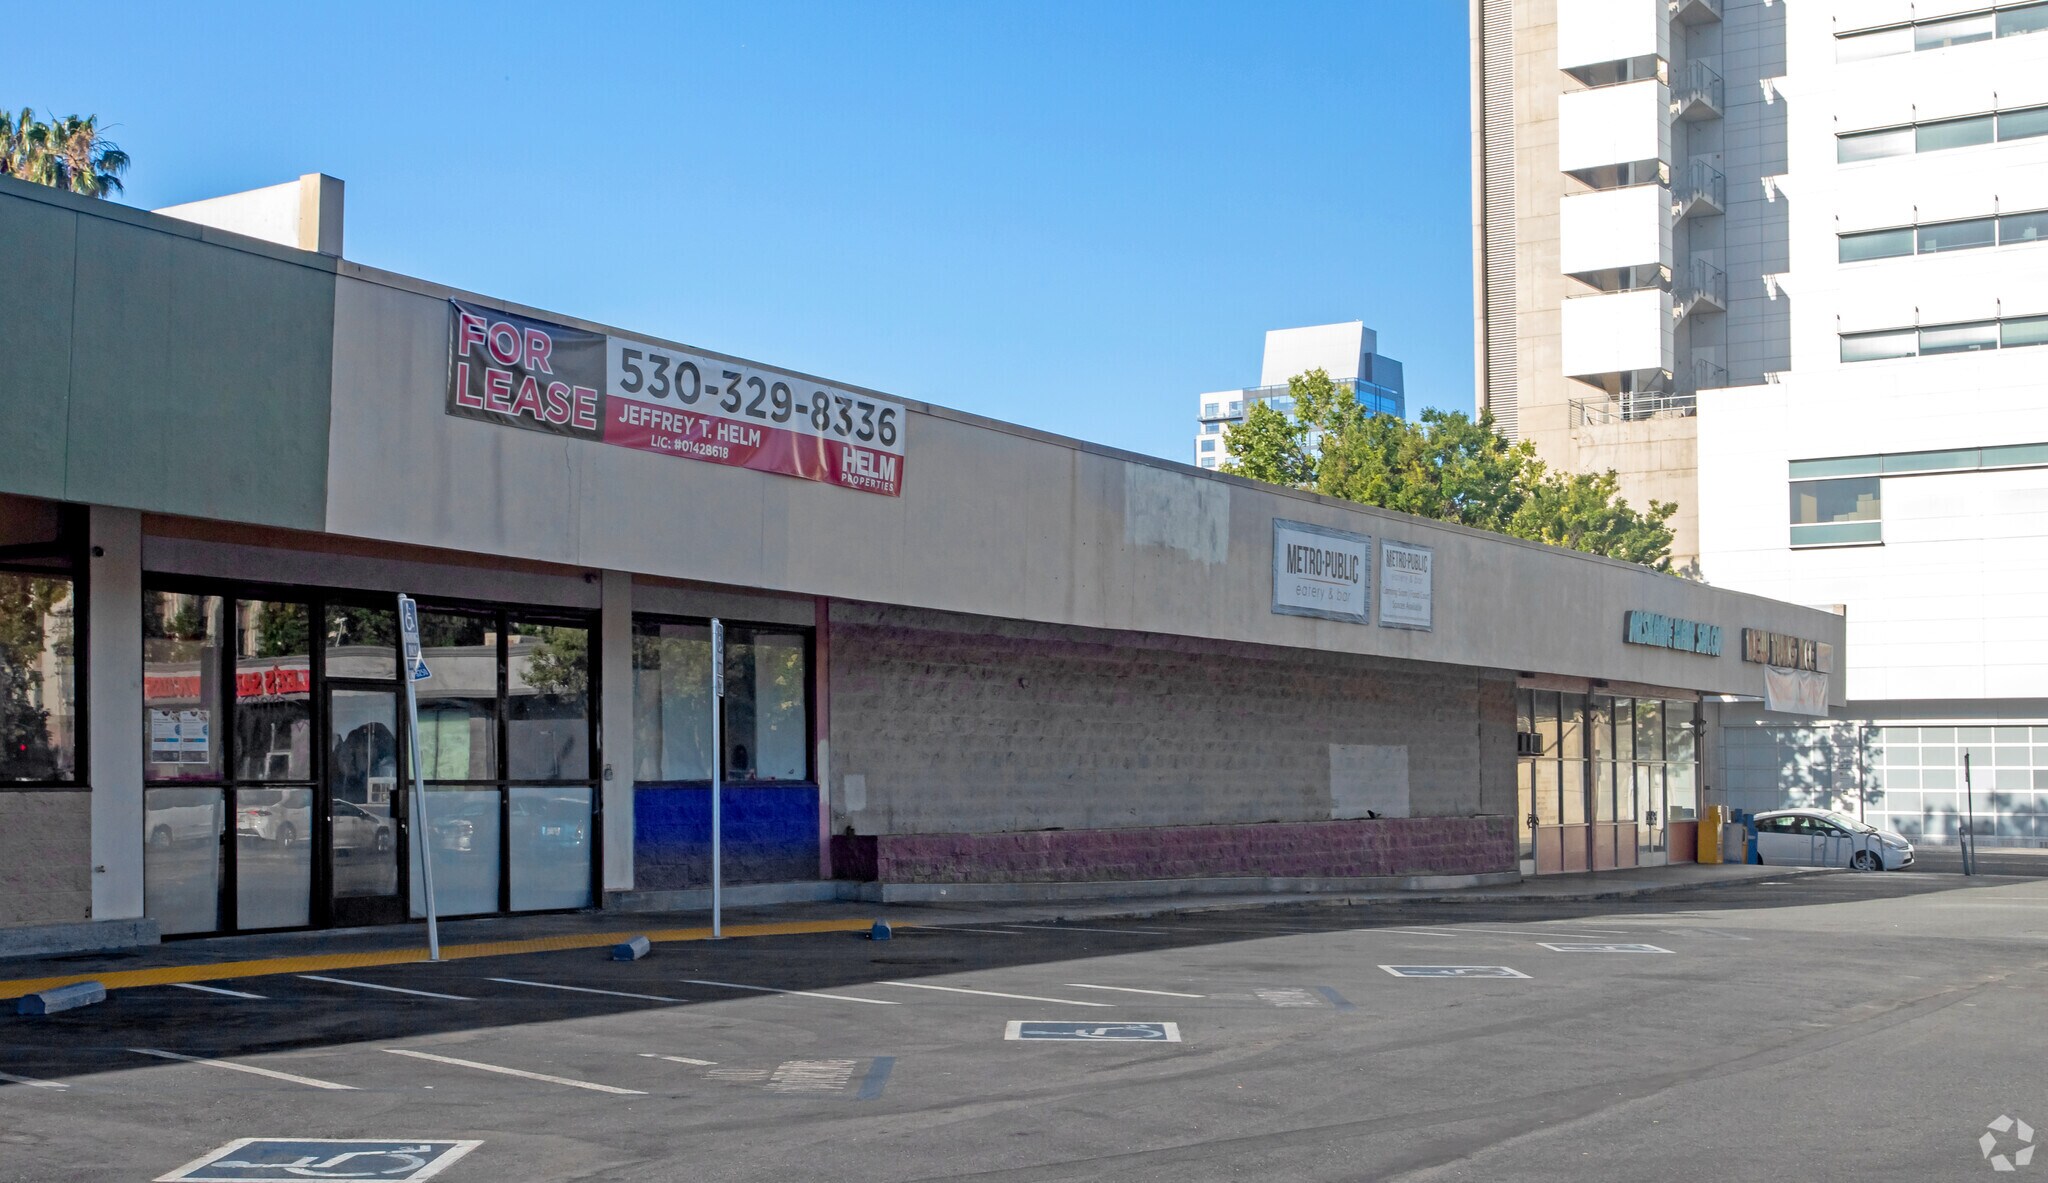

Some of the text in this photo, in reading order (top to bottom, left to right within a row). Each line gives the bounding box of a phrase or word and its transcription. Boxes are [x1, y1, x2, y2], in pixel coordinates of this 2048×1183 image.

[458, 312, 553, 375] FOR
[456, 362, 598, 431] LEASE
[619, 347, 897, 447] 530-329-8336
[618, 404, 761, 448] JEFFREY T. HELM
[650, 434, 729, 459] LIC: #01428618
[841, 447, 895, 482] HELM
[841, 473, 894, 492] PROPERTIES
[1296, 584, 1351, 602] eatery & bar
